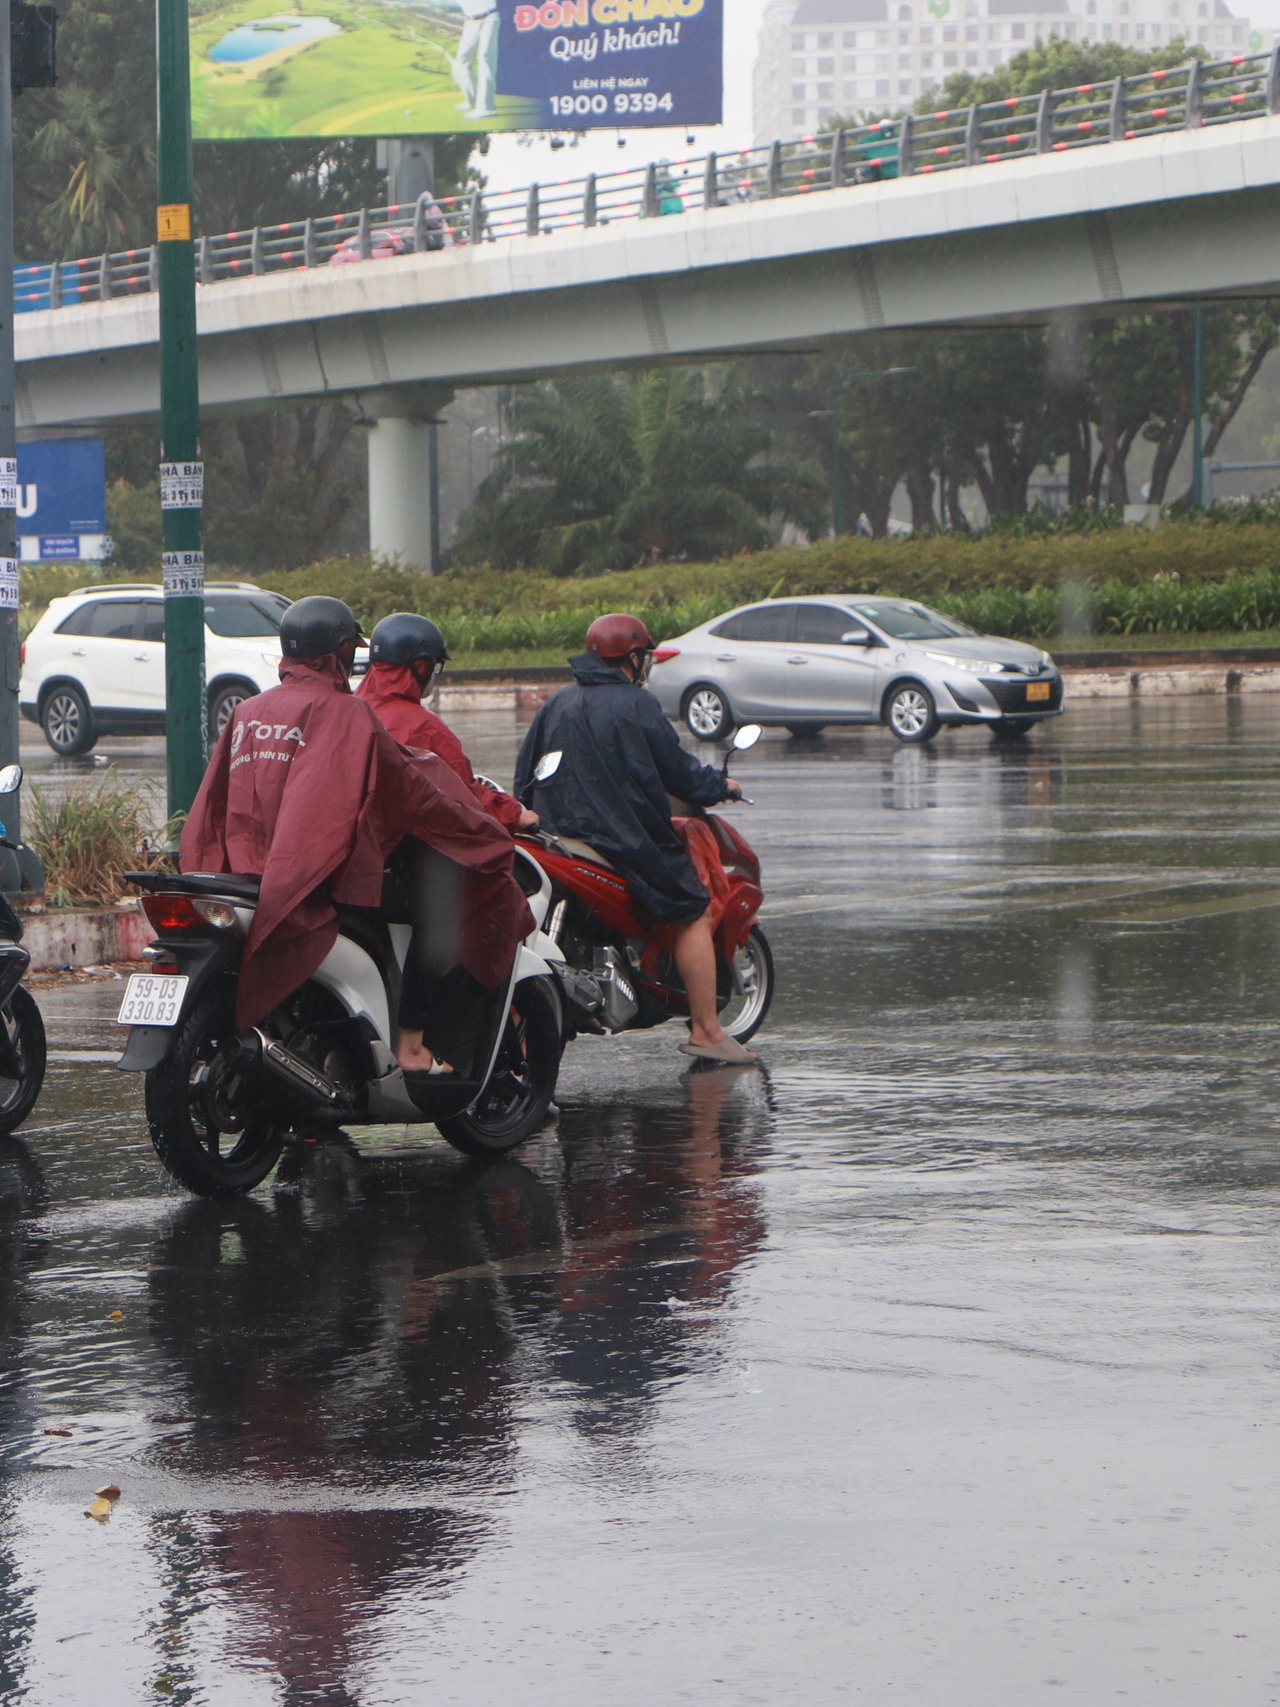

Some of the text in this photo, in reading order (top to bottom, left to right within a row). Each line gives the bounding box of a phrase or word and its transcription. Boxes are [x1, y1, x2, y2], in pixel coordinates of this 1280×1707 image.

[549, 21, 680, 61] Quý khách!
[573, 76, 649, 90] LIÊN HỆ NGAY
[550, 92, 673, 114] 1900 9394
[134, 979, 178, 999] 59-D3
[124, 1001, 176, 1021] 330.83
